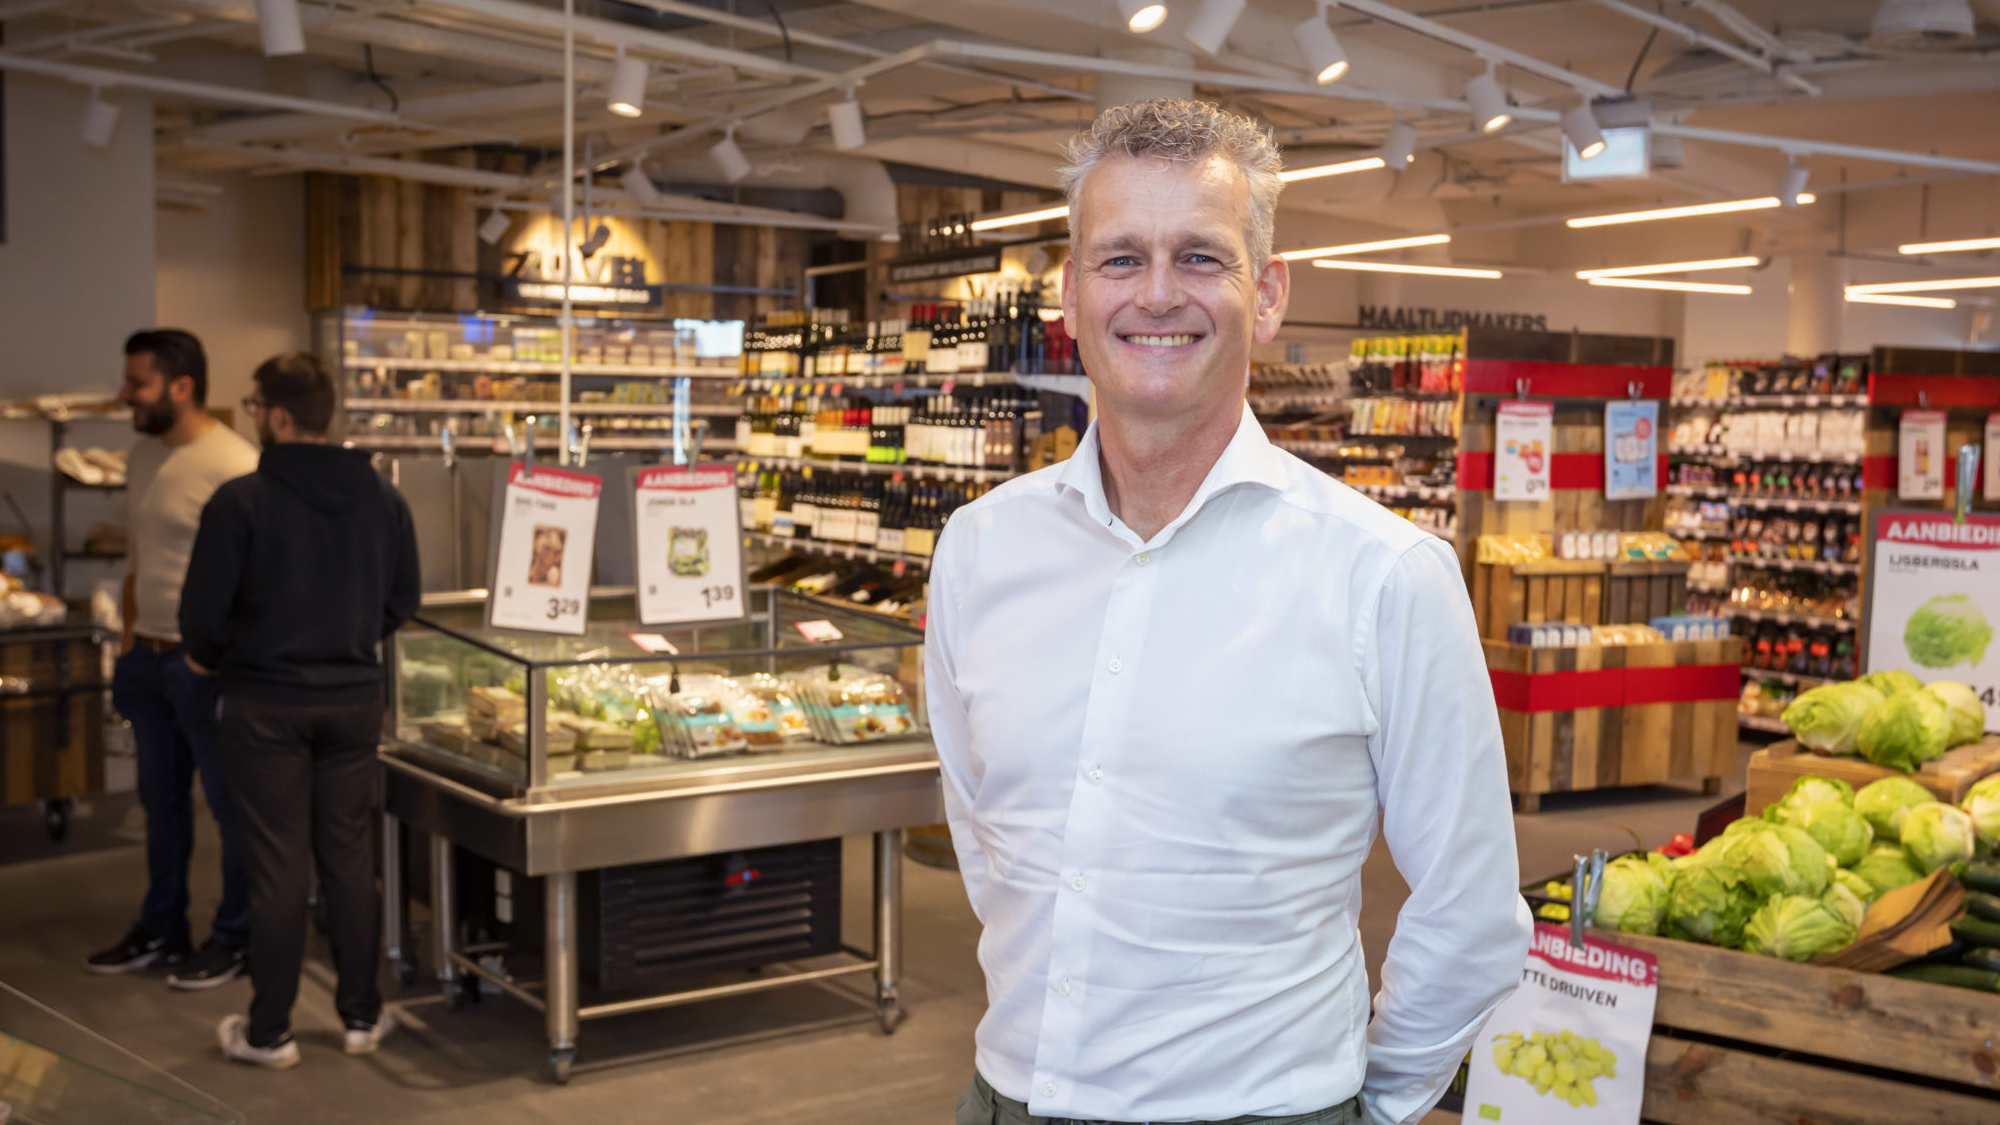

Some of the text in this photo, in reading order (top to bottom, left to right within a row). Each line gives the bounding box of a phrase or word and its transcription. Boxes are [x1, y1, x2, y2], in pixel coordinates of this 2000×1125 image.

[1886, 520, 2000, 546] AANBIEDI
[1889, 554, 1980, 570] IJSBERGSLA
[1549, 977, 1619, 1008] DRUIVEN
